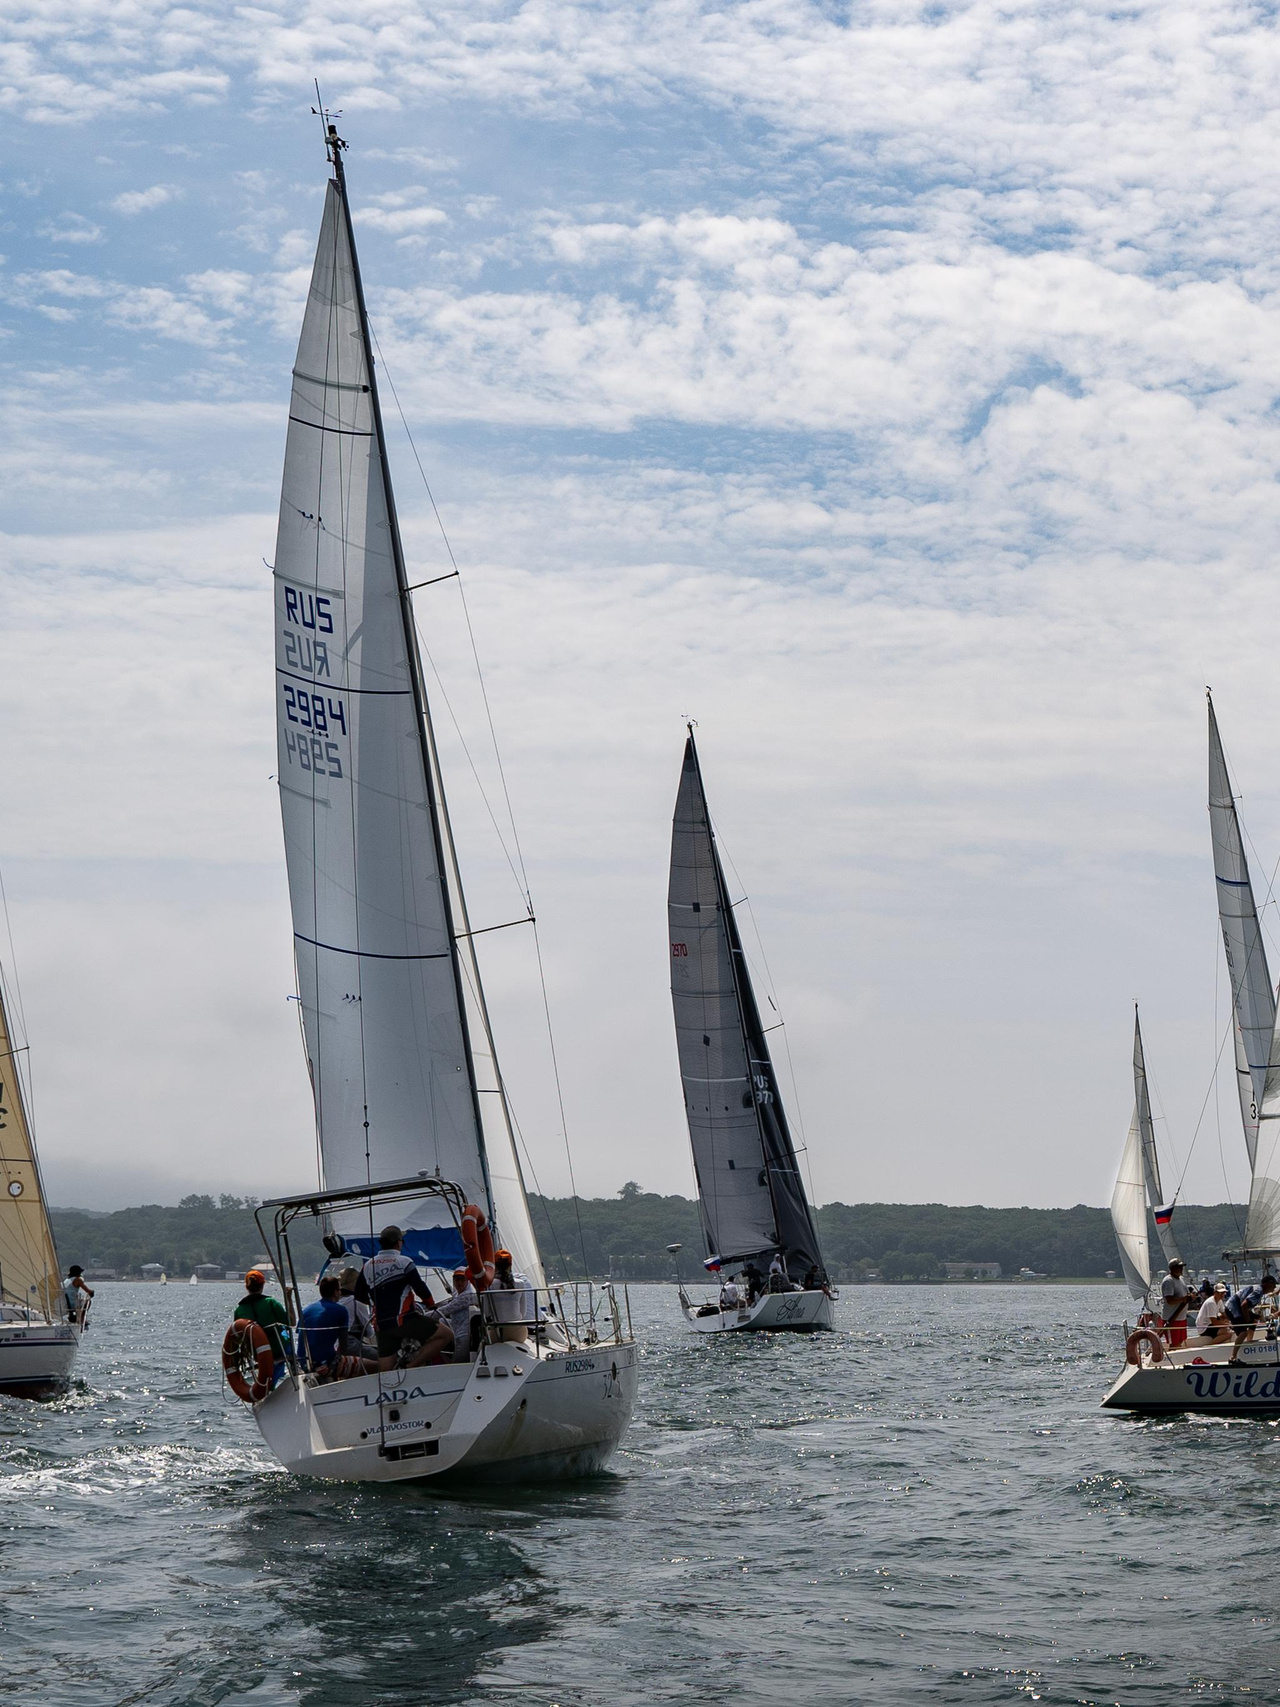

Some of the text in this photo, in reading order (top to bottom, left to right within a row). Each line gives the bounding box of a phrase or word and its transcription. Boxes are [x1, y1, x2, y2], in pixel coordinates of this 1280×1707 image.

[284, 586, 333, 634] RUS
[284, 684, 347, 736] 2984
[565, 1358, 592, 1373] RUS2984
[364, 1386, 425, 1406] LADA
[366, 1420, 424, 1435] VLADIVOSTOK
